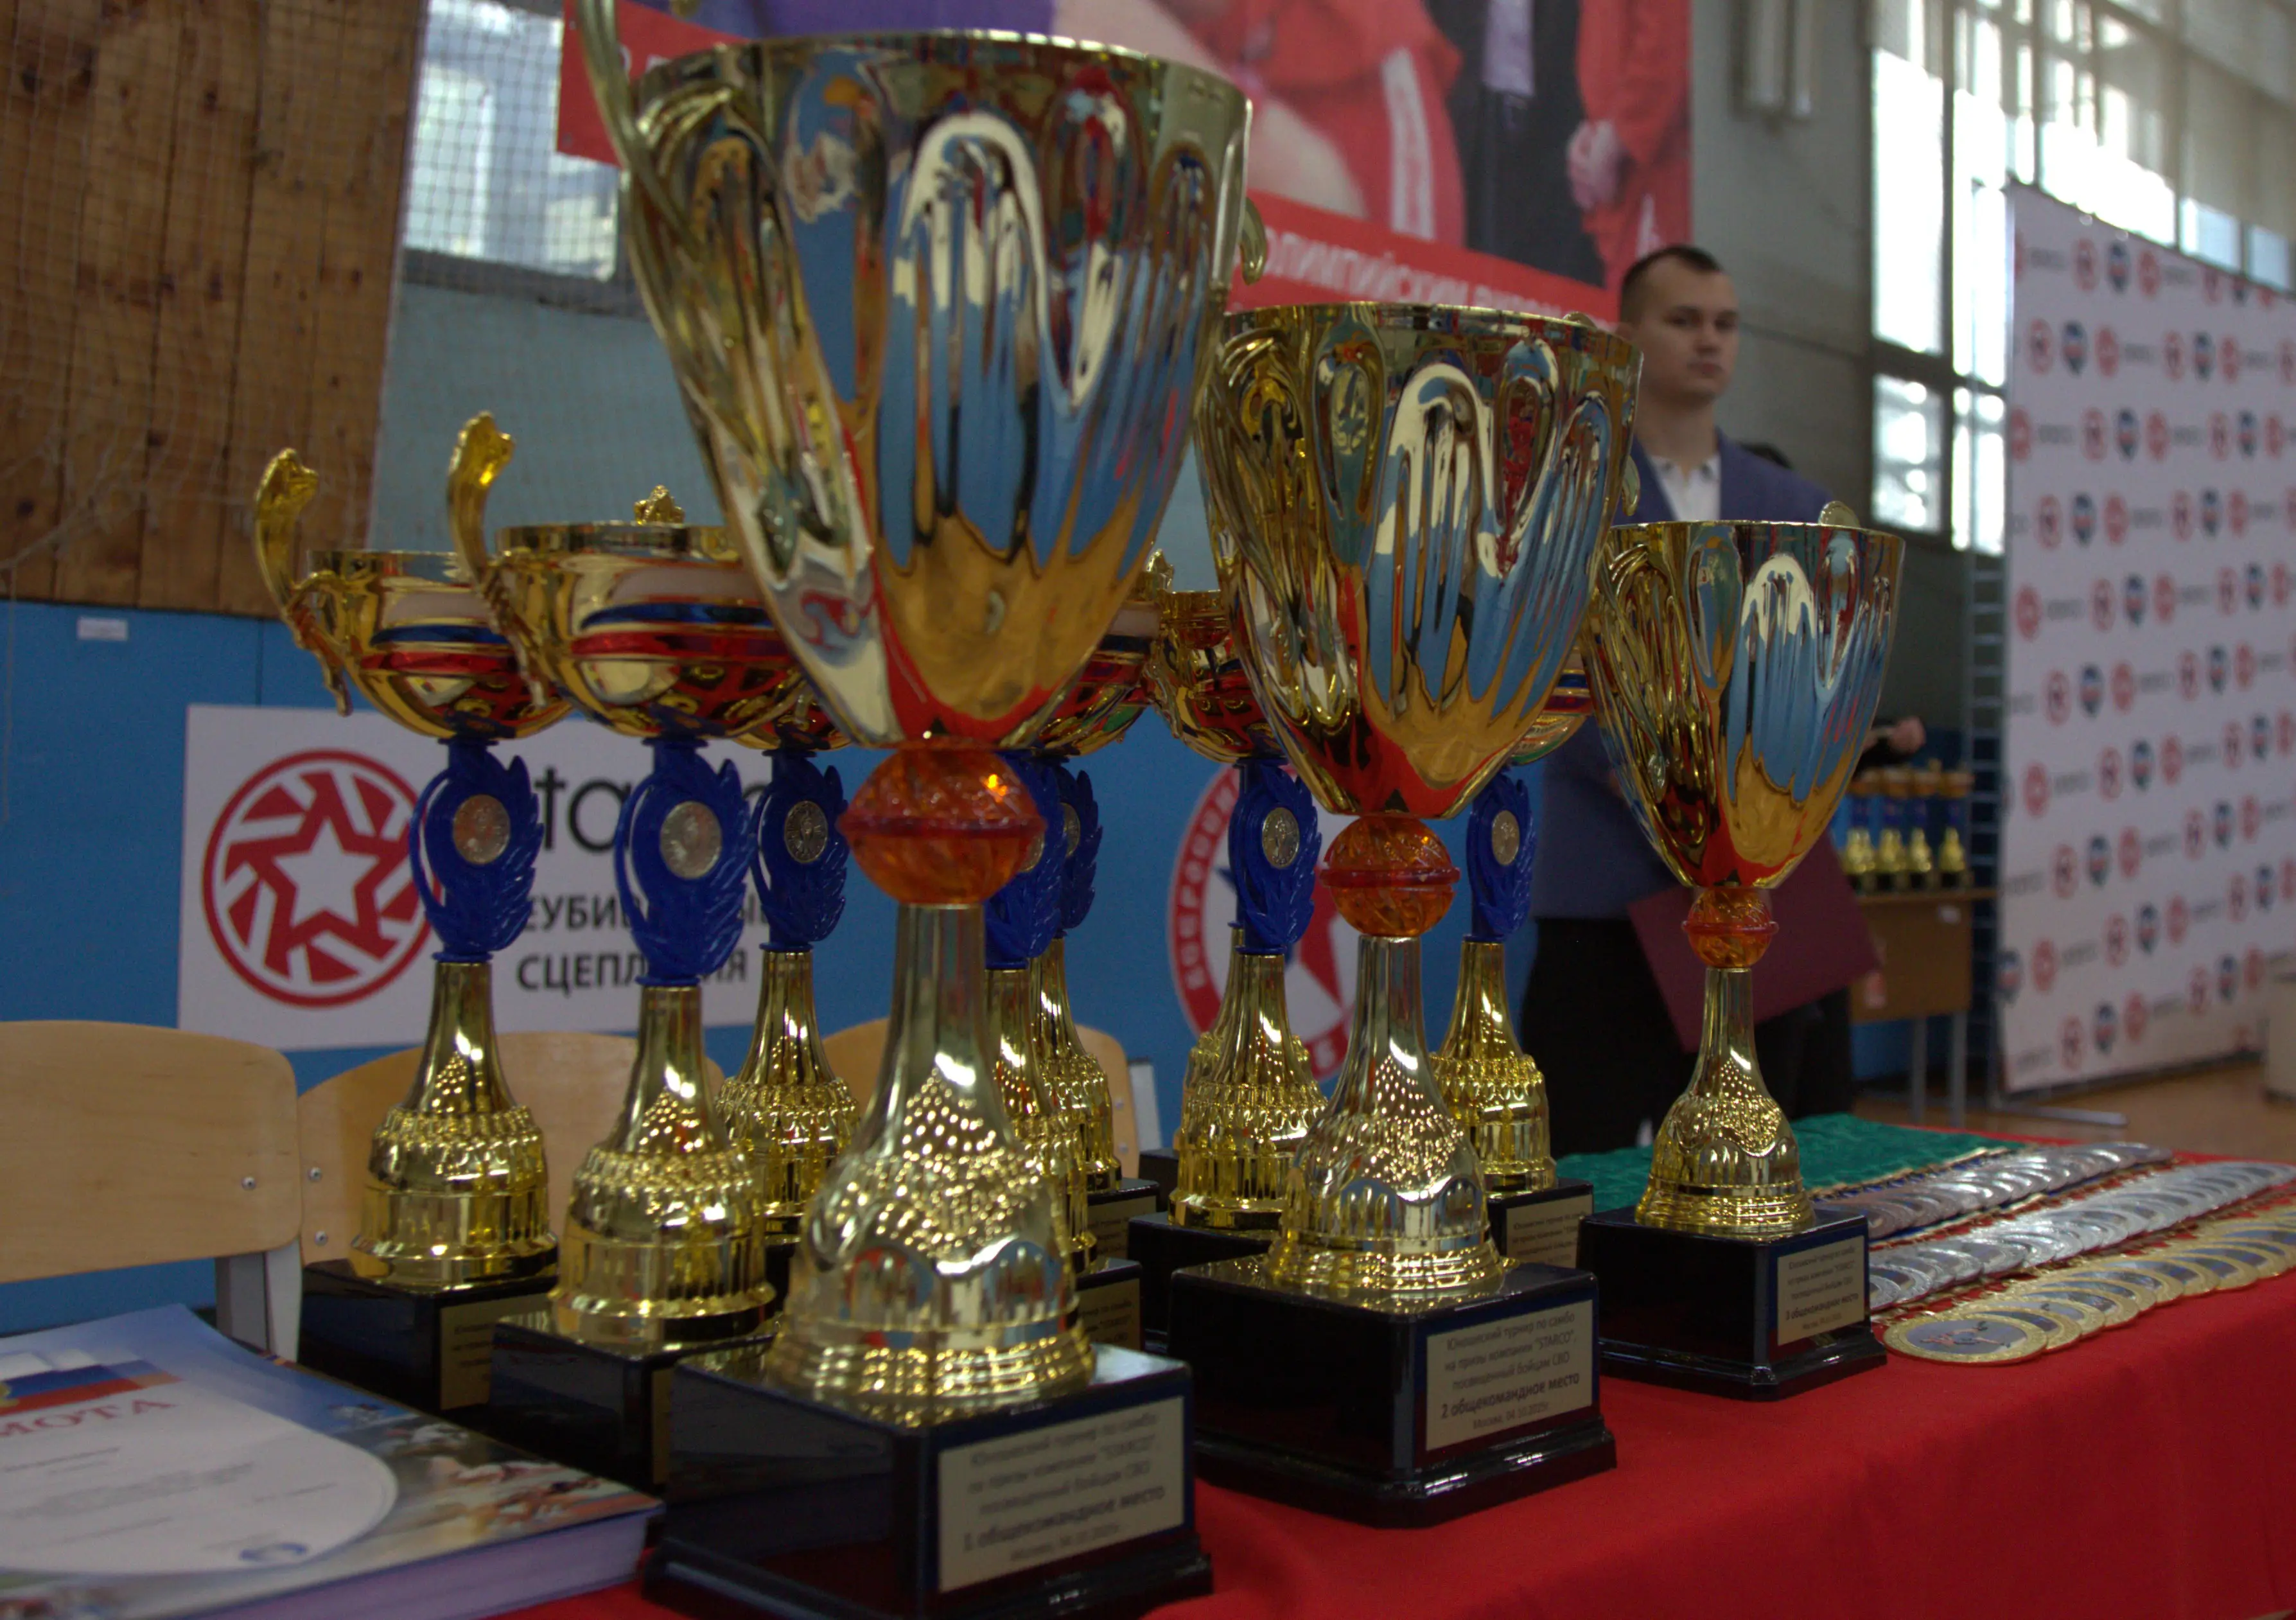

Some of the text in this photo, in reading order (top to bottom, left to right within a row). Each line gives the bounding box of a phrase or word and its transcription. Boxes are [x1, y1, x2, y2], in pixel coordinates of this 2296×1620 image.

[1503, 1322, 1534, 1339] турнир
[1536, 1319, 1547, 1329] по
[1548, 1310, 1575, 1327] самбо
[1517, 1359, 1550, 1374] бойцам
[1441, 1373, 1579, 1419] 2 общекомандное место
